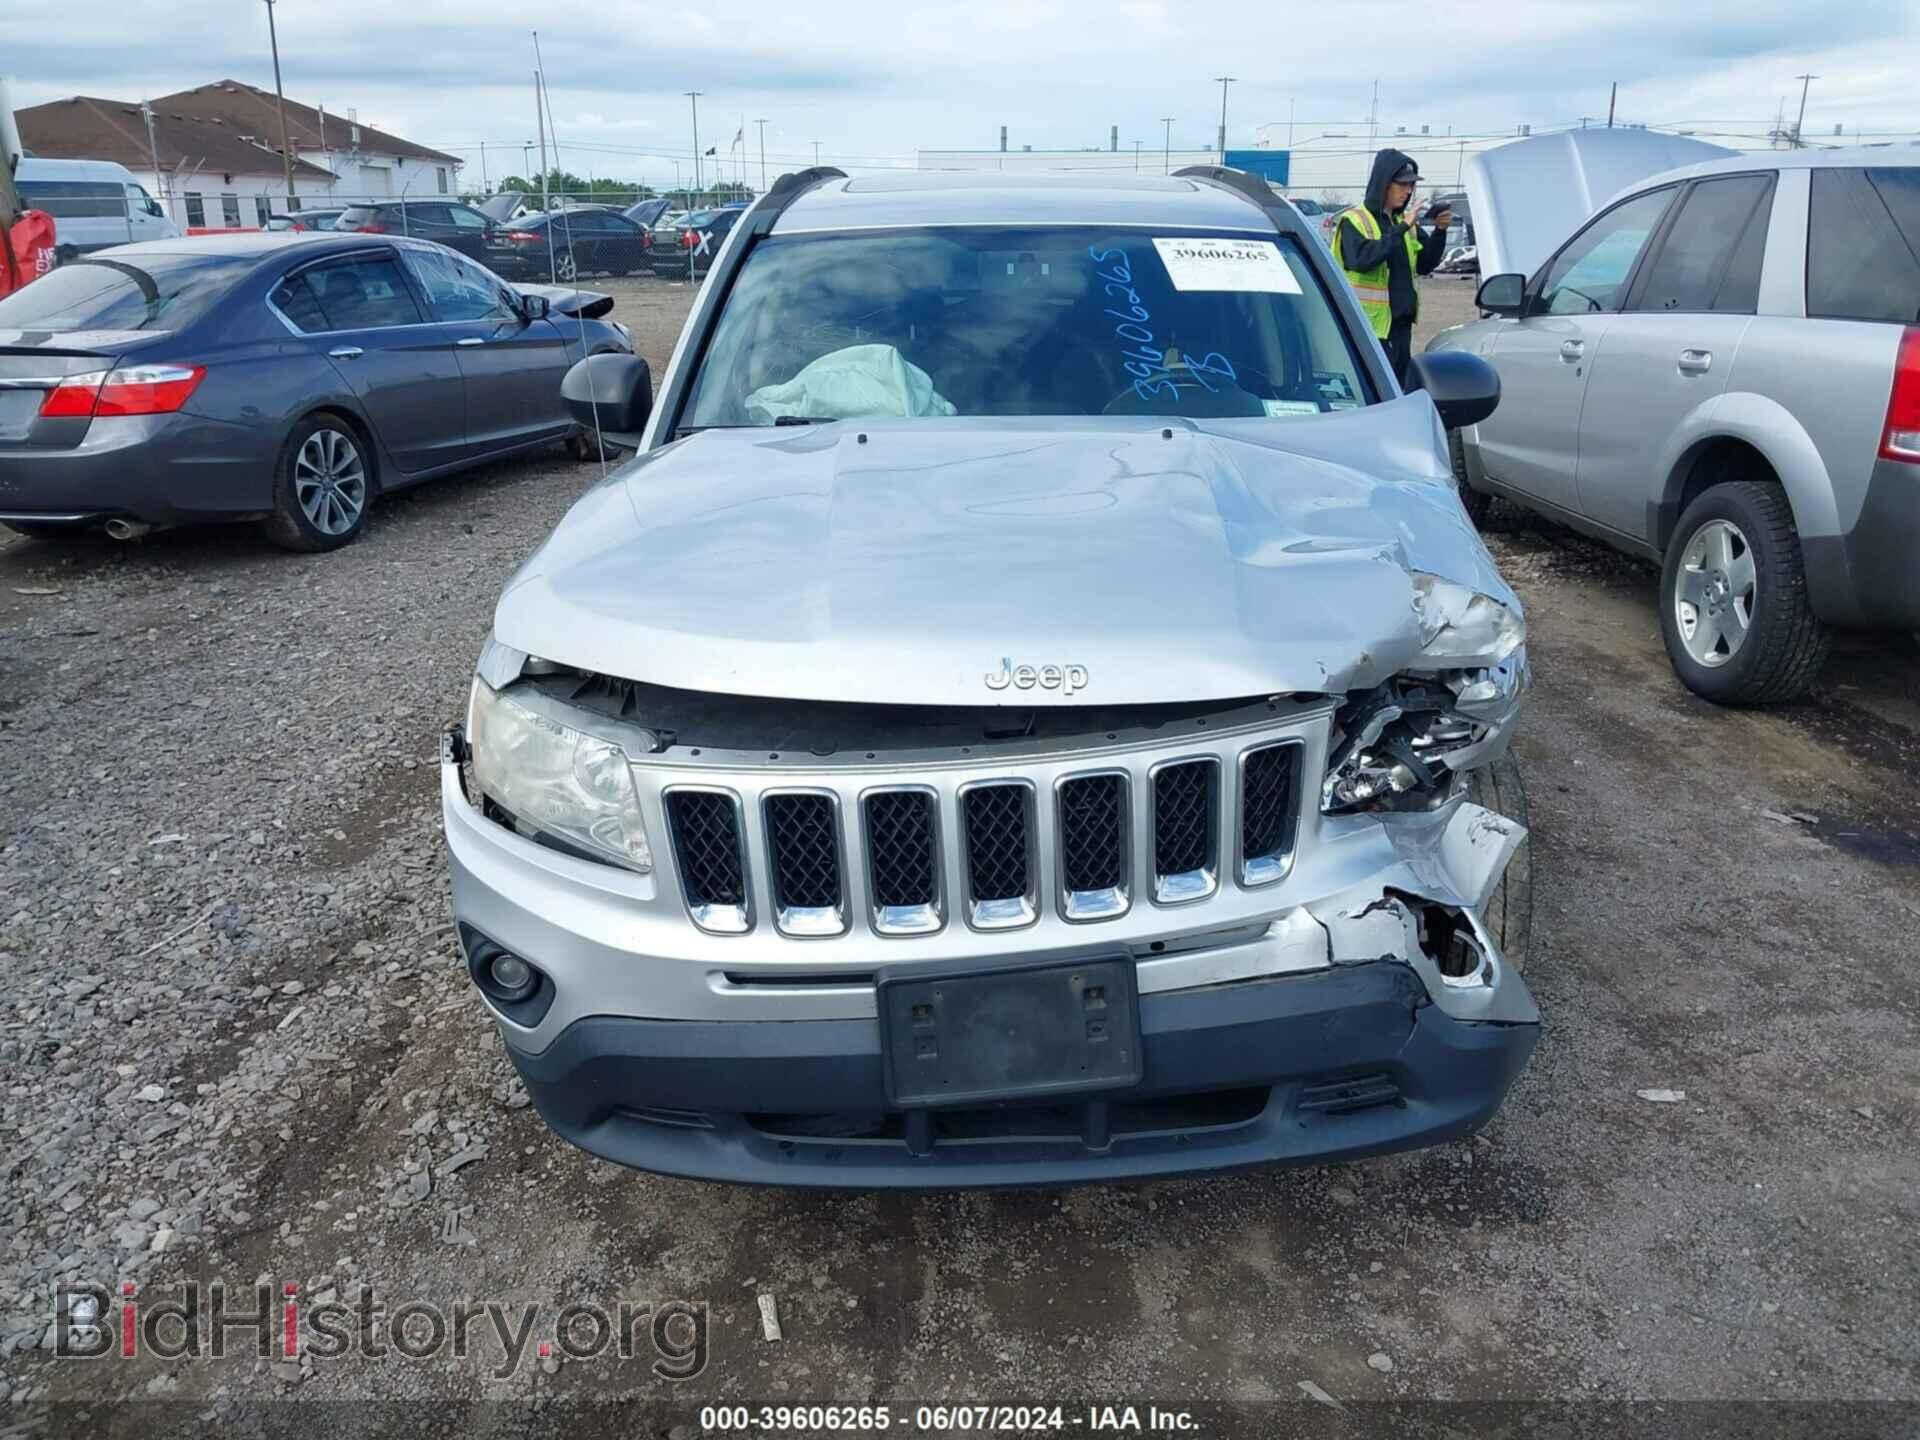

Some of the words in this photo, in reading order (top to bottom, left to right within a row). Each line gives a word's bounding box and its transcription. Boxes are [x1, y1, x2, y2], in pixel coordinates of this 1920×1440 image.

[1172, 248, 1270, 261] 39606265
[1087, 245, 1179, 402] 39606265
[984, 657, 1089, 696] Jeep
